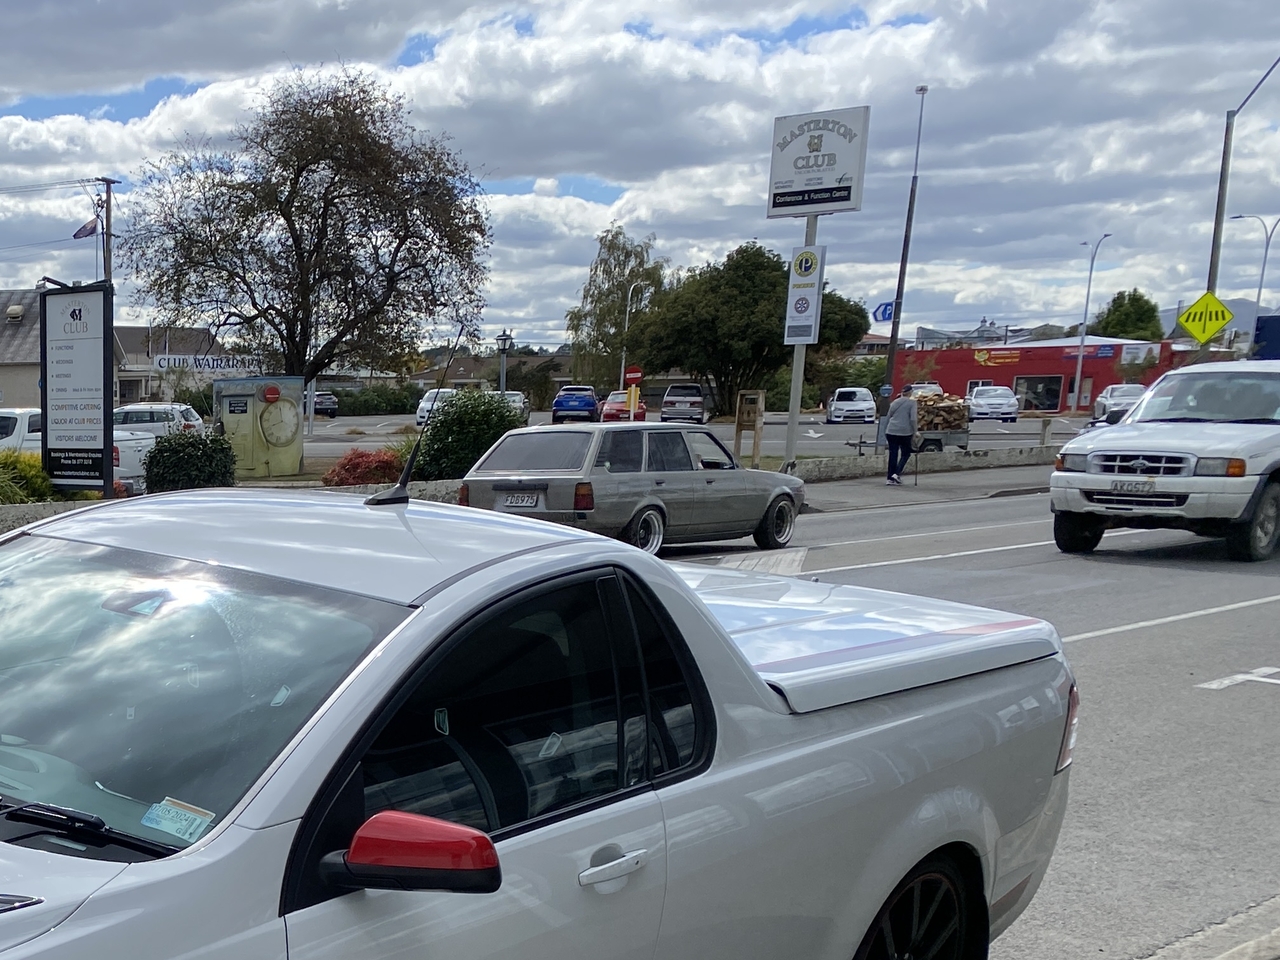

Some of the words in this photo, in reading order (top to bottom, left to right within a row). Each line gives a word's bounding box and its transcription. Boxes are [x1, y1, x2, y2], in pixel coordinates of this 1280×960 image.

[776, 119, 858, 152] MASTERTON
[793, 153, 837, 170] CLUB
[775, 194, 802, 203] Conference
[60, 300, 91, 316] MASTERTON
[886, 305, 892, 318] P
[63, 322, 88, 334] CLUB
[158, 357, 189, 369] CLUB
